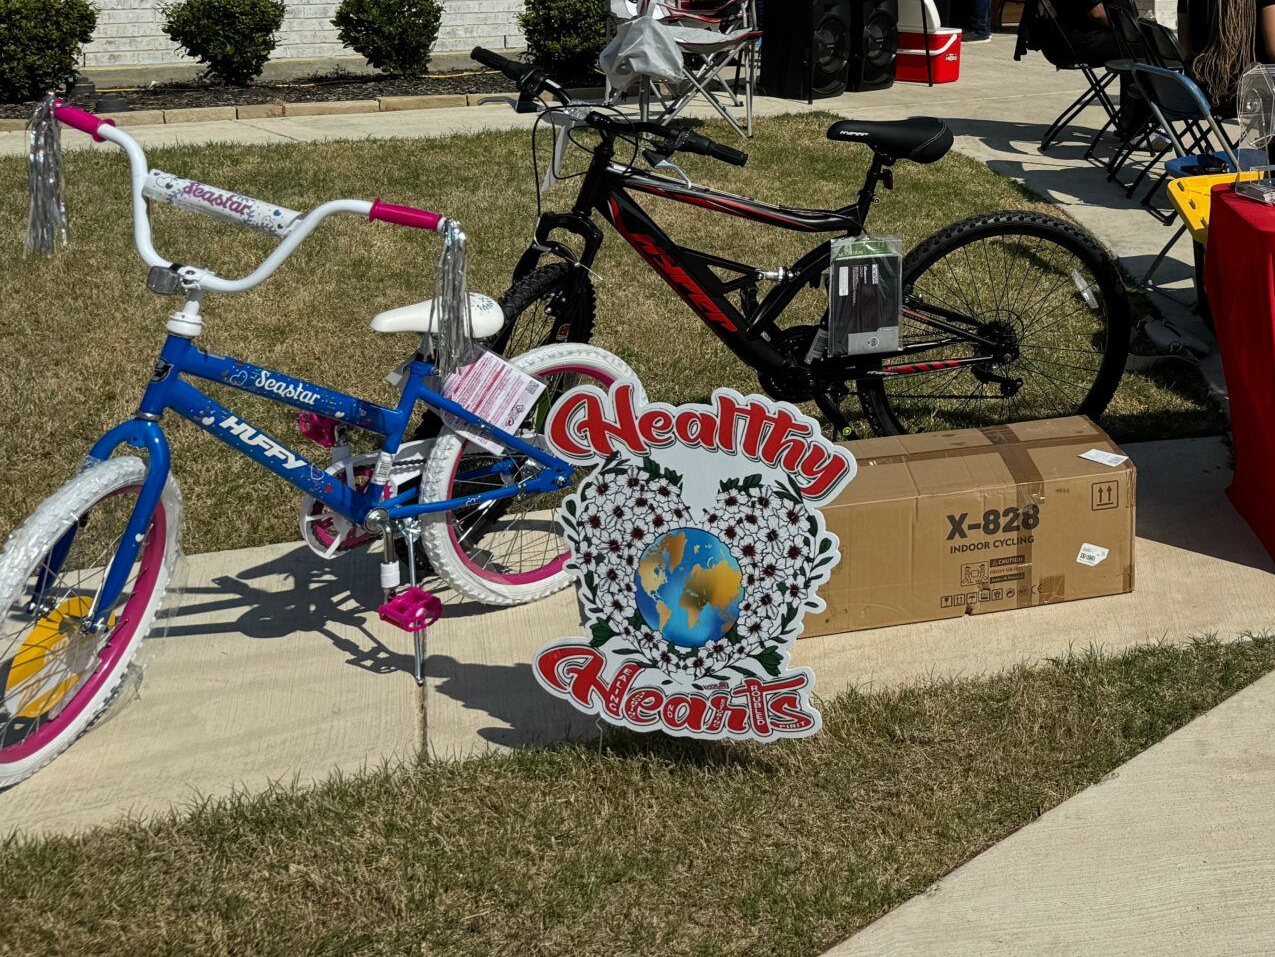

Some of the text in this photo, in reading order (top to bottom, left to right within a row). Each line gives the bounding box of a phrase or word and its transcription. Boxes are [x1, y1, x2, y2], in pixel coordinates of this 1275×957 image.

[183, 181, 252, 215] Seastar
[255, 370, 321, 405] Seastar
[219, 415, 308, 469] HUFFY
[549, 384, 849, 499] Healthy
[945, 503, 1040, 541] X-828
[950, 535, 1035, 555] INDOOR CYCLING
[998, 556, 1024, 566] CAUTION
[537, 644, 815, 736] Hearts
[750, 684, 765, 726] ROUBLED
